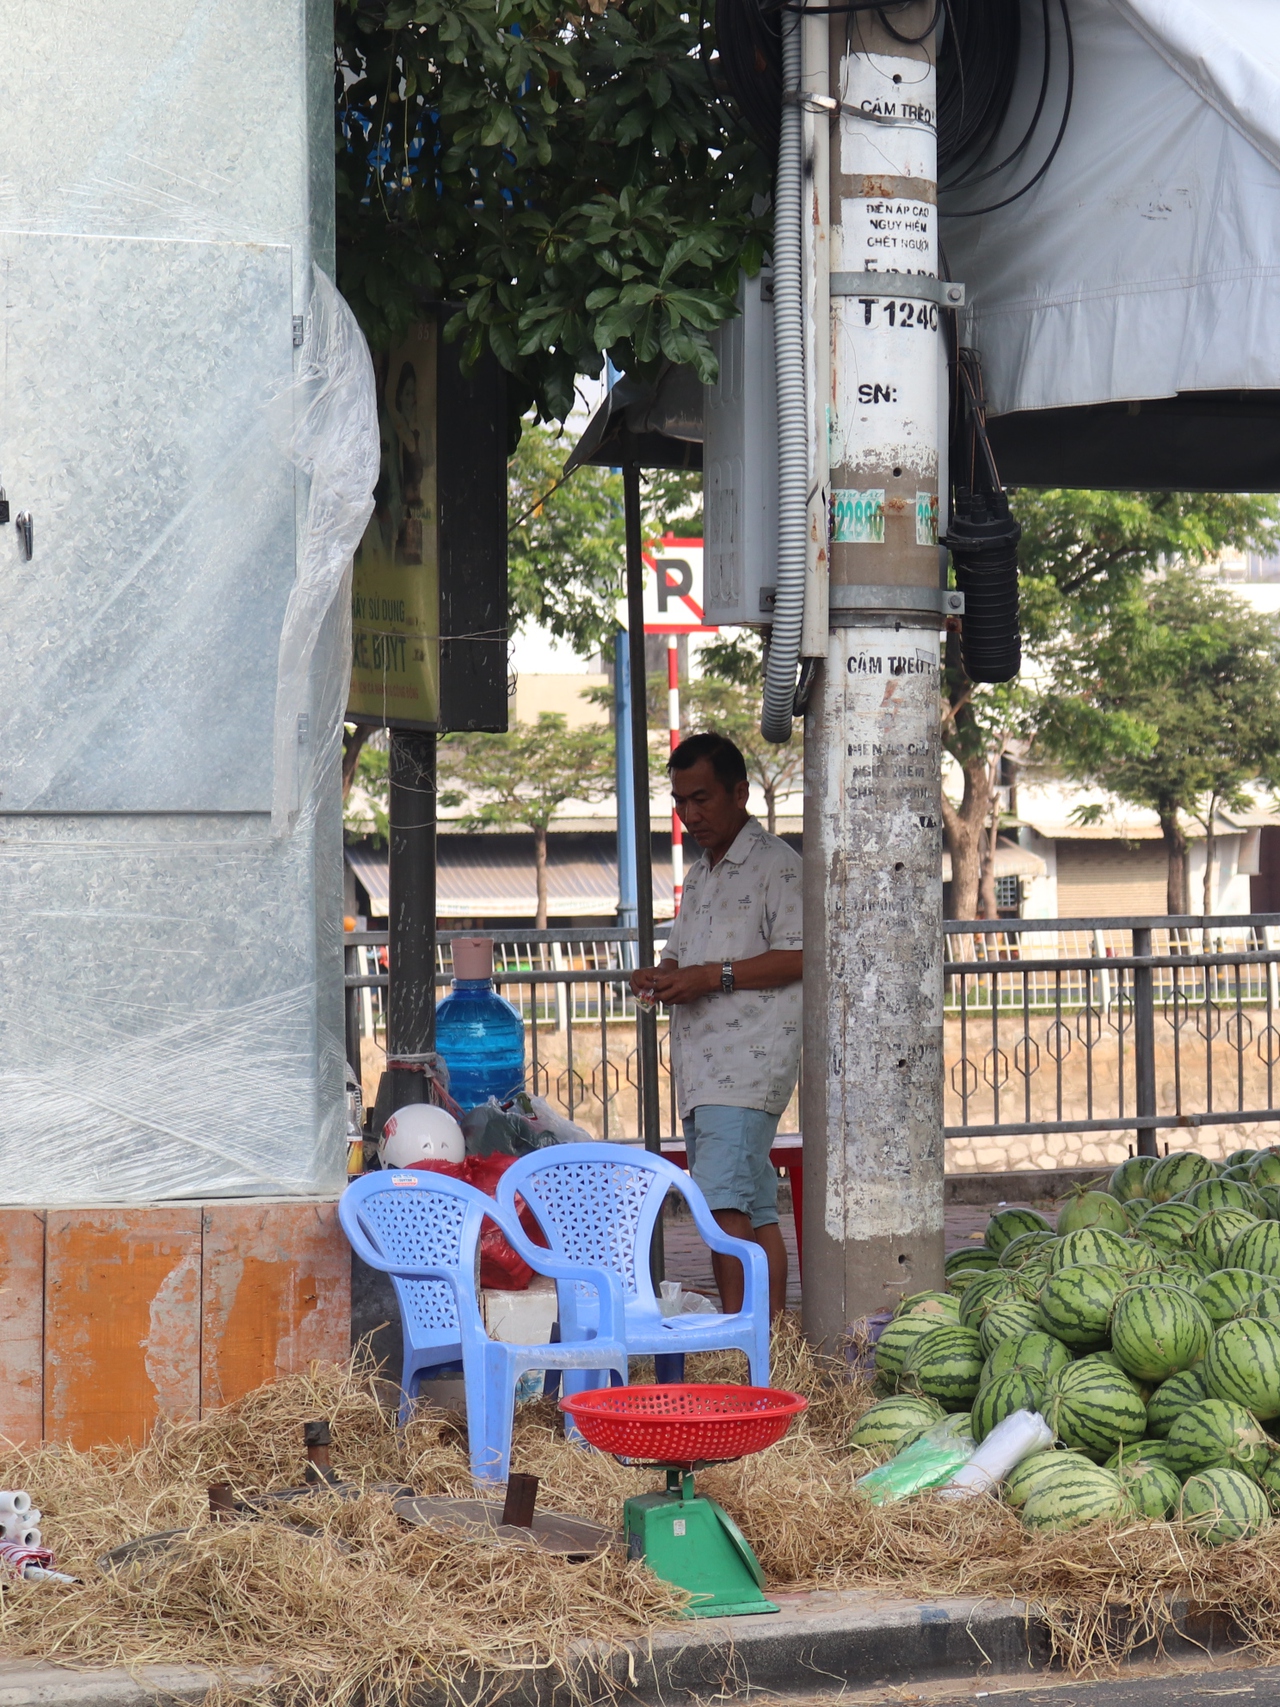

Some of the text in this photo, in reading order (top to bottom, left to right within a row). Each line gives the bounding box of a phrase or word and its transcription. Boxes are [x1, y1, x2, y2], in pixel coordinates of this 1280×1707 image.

[870, 219, 902, 230] NGUY
[858, 383, 897, 404] SN:
[847, 649, 882, 674] CẤM
